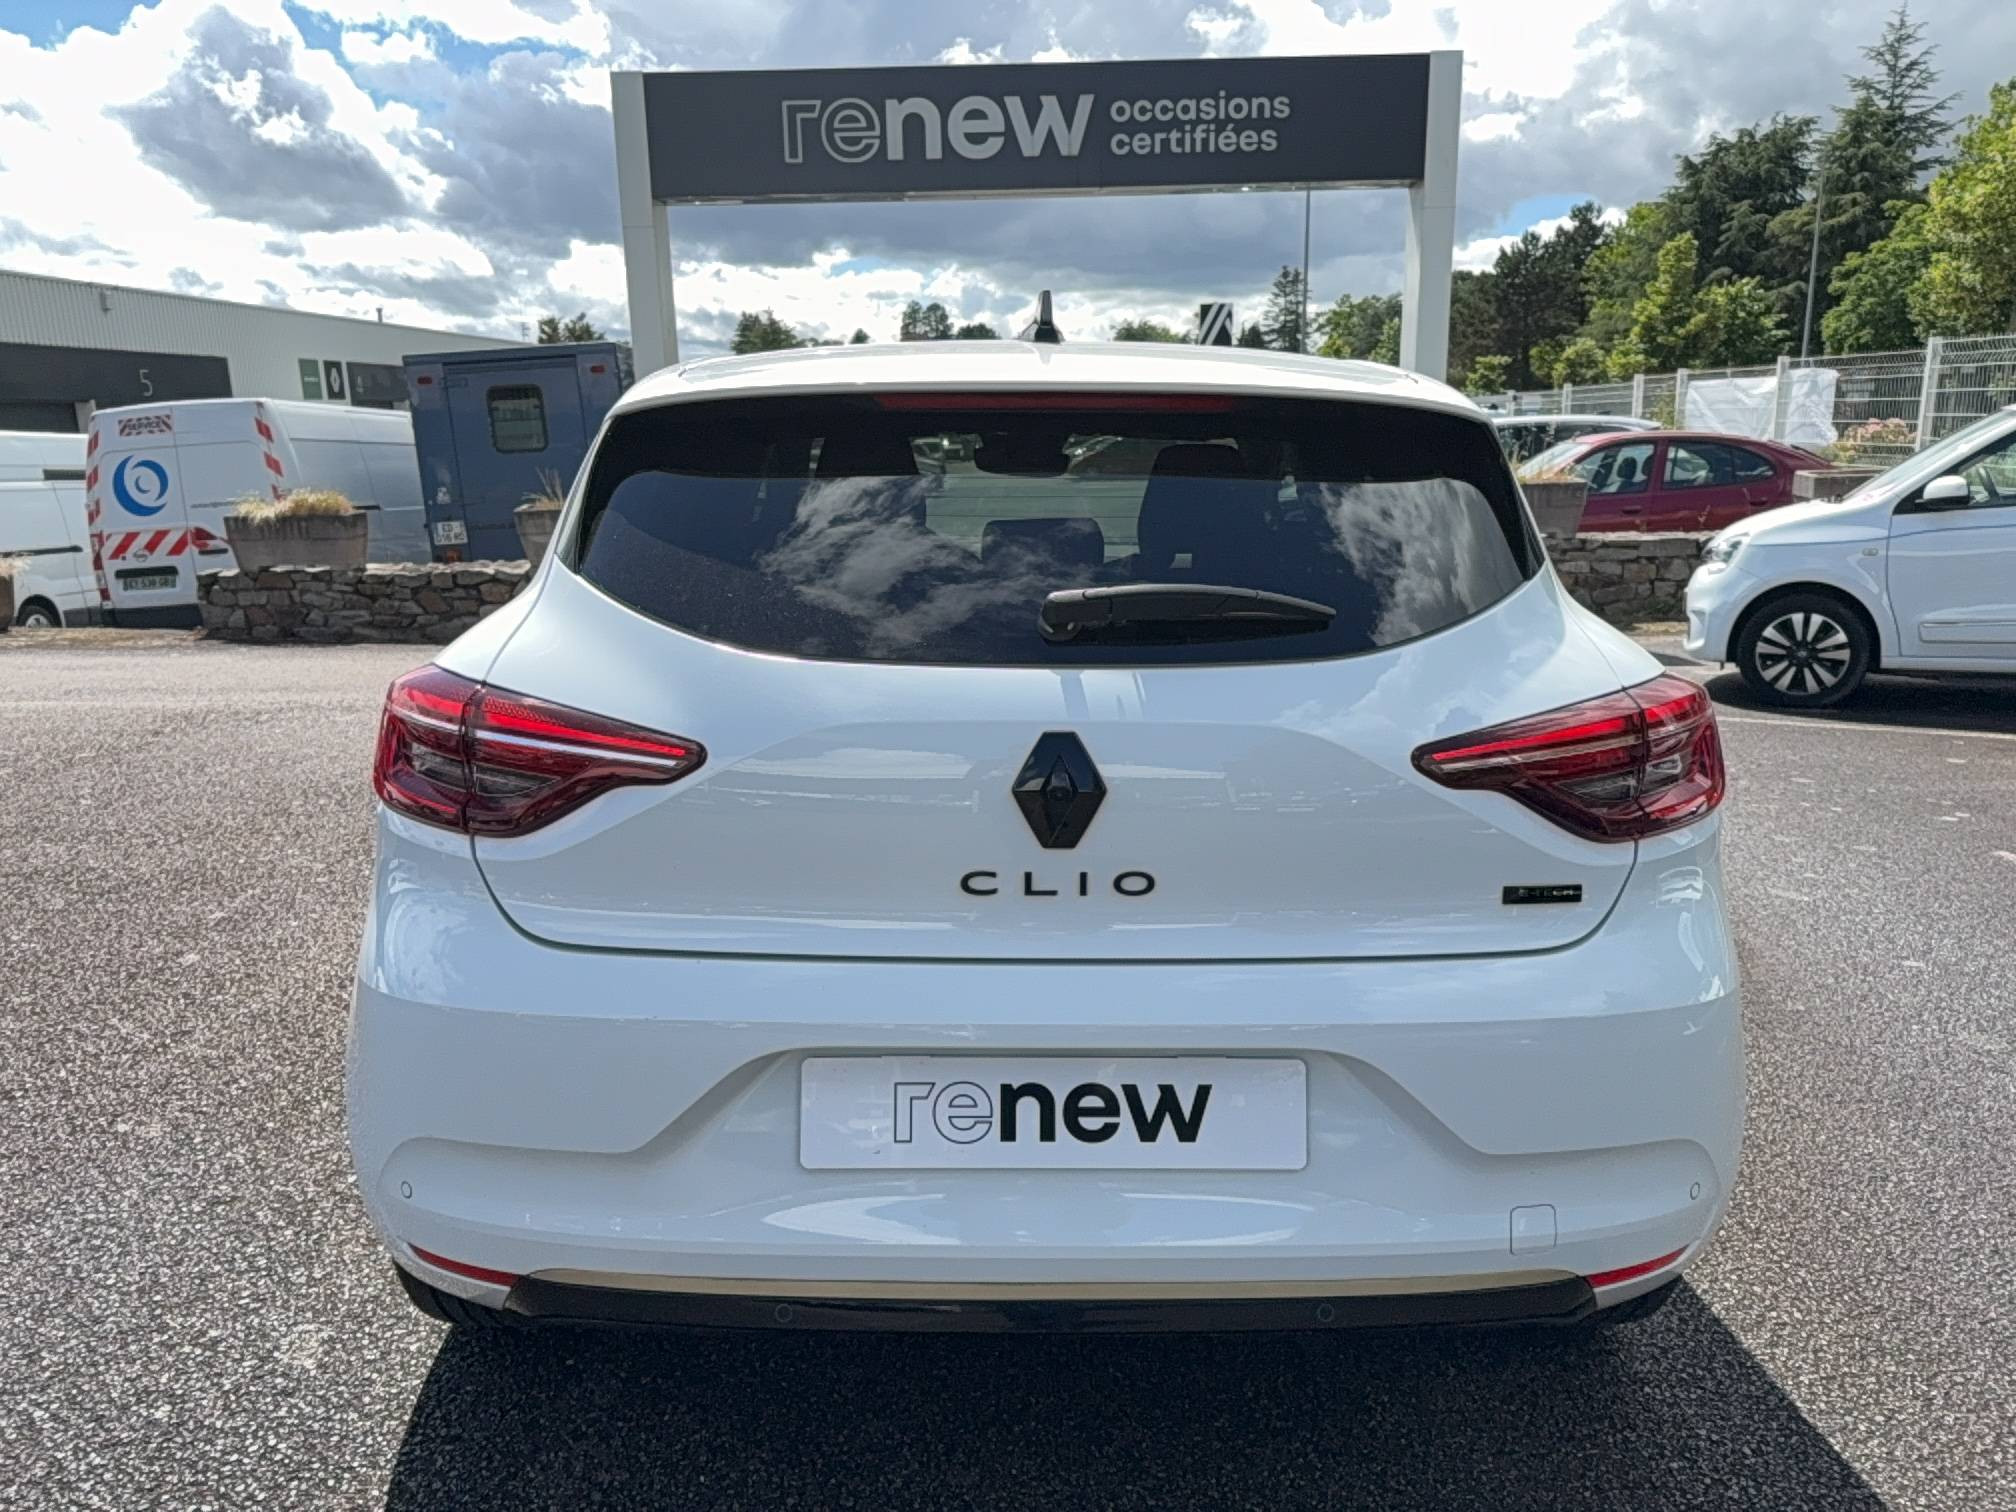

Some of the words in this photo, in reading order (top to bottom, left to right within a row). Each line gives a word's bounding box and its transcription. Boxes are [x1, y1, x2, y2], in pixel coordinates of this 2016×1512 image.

[1110, 90, 1291, 122] occasions
[781, 94, 1095, 163] renew
[1110, 123, 1278, 155] certifiées
[139, 369, 152, 396] 5
[960, 870, 1155, 896] CLIO
[894, 1081, 1212, 1144] renew
